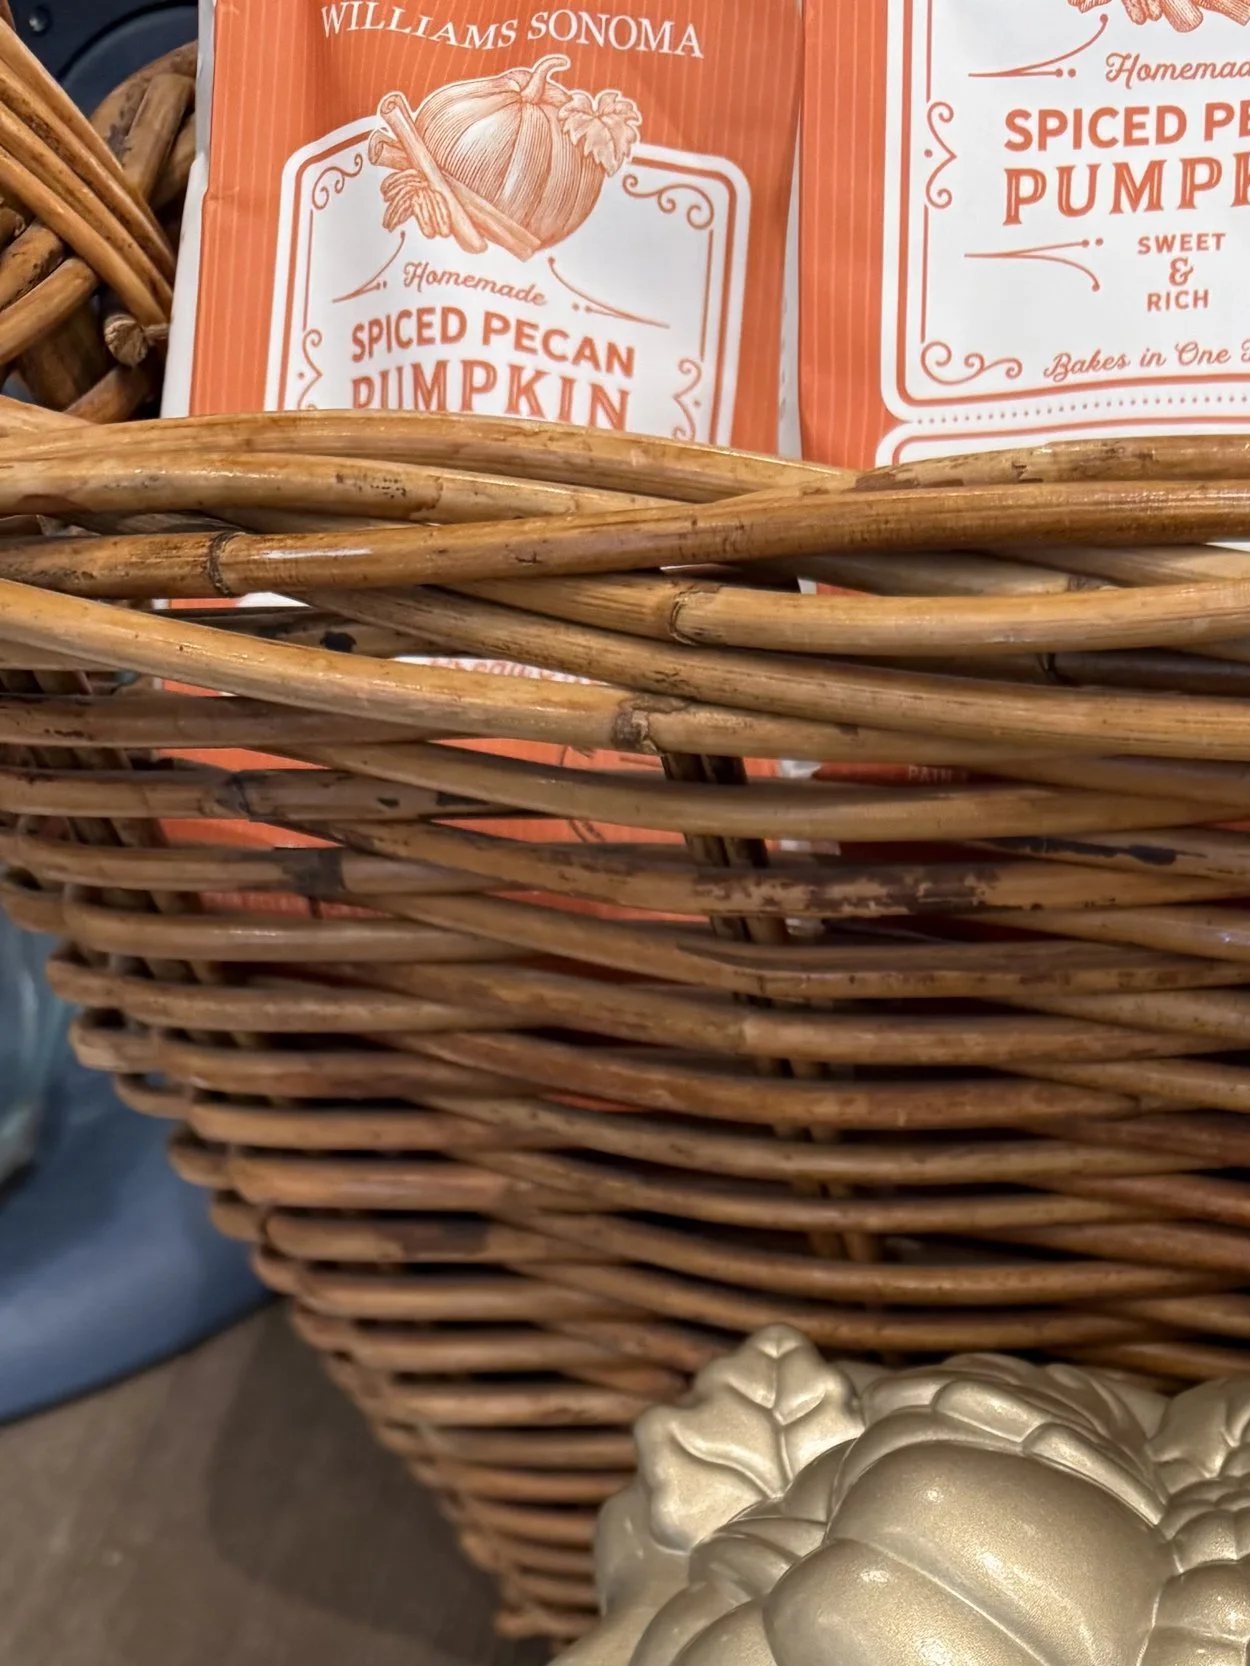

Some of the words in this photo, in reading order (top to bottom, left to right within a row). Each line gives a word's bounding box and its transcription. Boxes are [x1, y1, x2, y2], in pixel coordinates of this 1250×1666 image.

[321, 0, 519, 50] WILLIAMS
[527, 9, 704, 59] SONOMA
[1004, 106, 1188, 152] SPICED
[1137, 233, 1226, 254] SWEET
[402, 261, 547, 306] Homemade
[1169, 257, 1194, 286] &
[1147, 289, 1210, 312] RICH
[351, 306, 468, 362] SPICED
[482, 311, 635, 377] PECAN
[1043, 349, 1131, 383] Bakes
[1140, 347, 1167, 367] in
[1175, 341, 1231, 364] One
[351, 359, 631, 431] PUMPKIN
